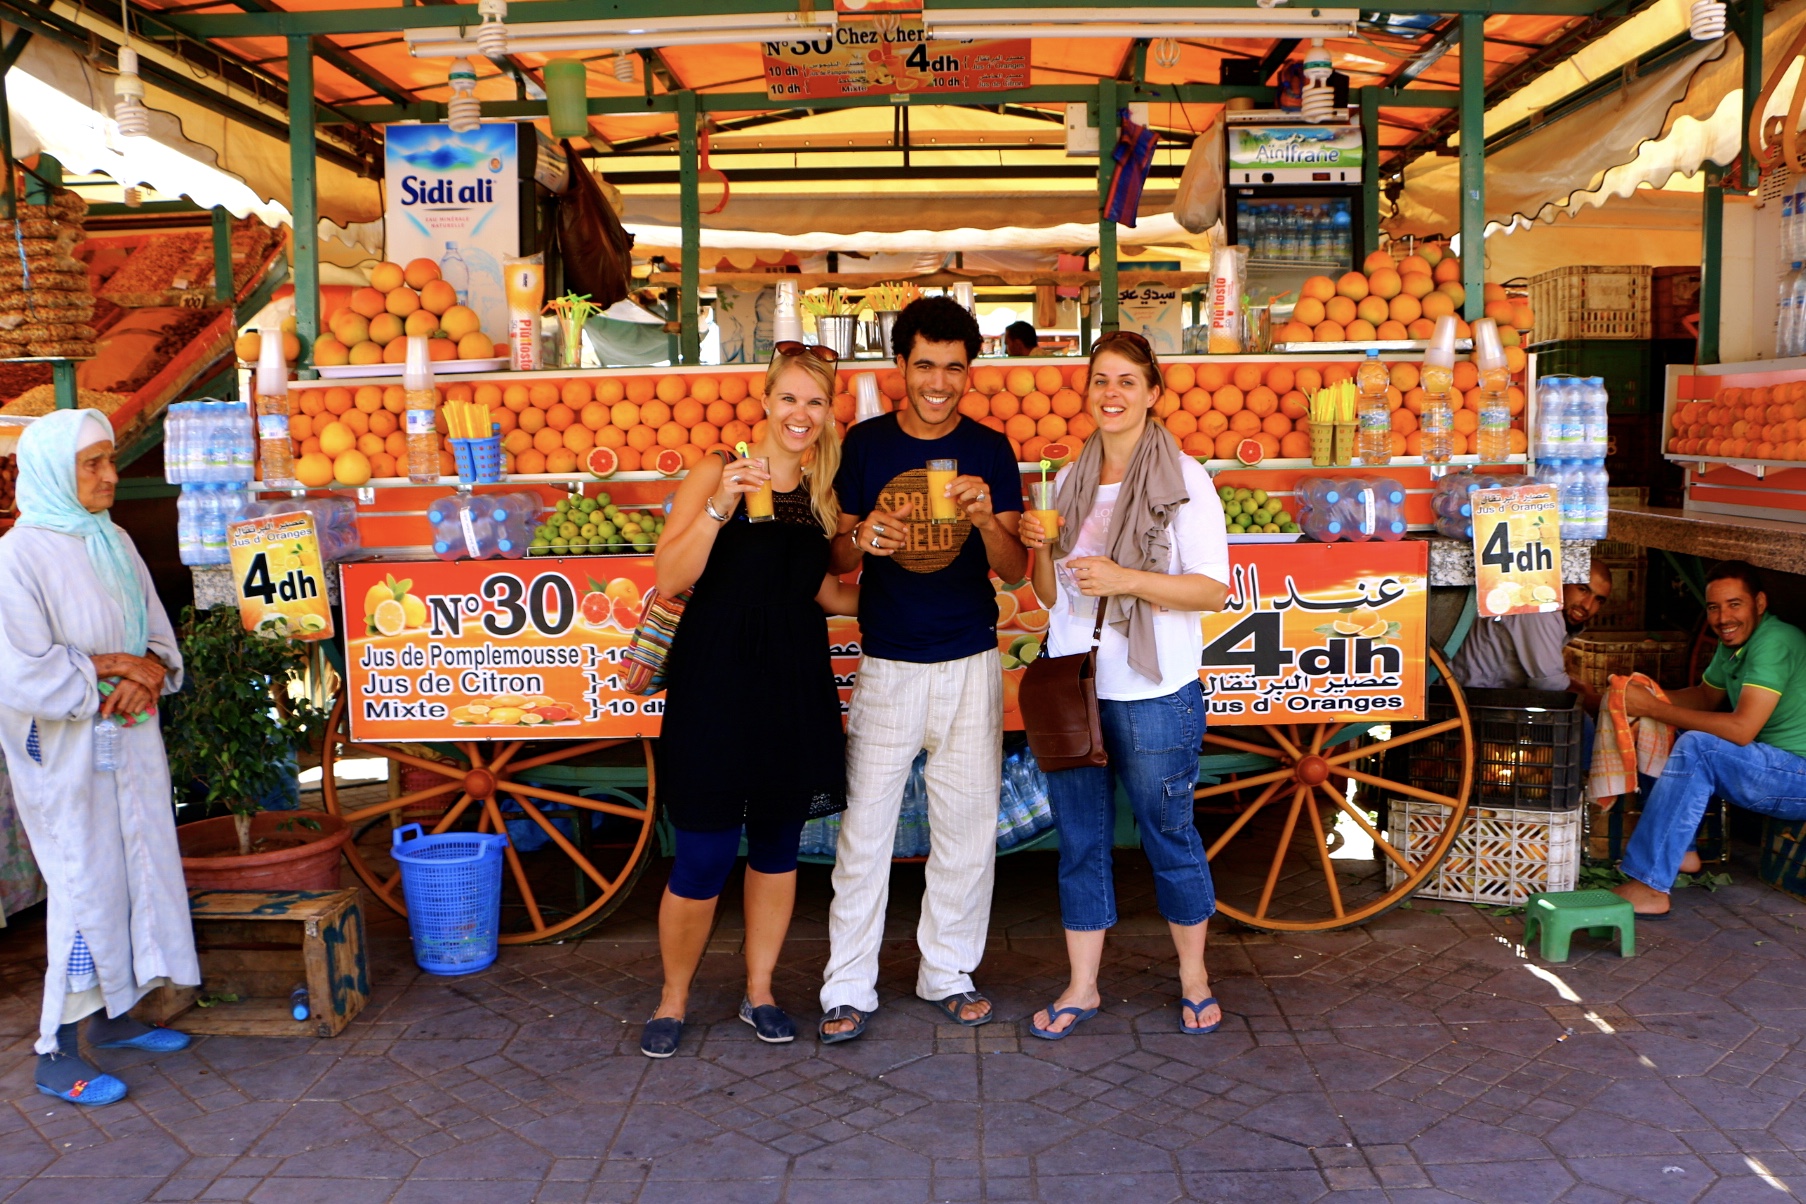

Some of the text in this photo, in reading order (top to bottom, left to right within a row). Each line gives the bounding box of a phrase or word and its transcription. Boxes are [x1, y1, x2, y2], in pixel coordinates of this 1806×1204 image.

[836, 27, 878, 45] Chez
[769, 65, 798, 76] 10 dh
[771, 83, 800, 94] 10 dh
[842, 85, 867, 93] Mixte
[933, 77, 959, 87] 10 dh
[401, 175, 493, 206] Sidi ali
[1477, 506, 1494, 514] Jus
[232, 538, 250, 547] Jus
[1274, 577, 1405, 610] عند
[362, 643, 580, 671] Jus de Pomplemousse
[363, 671, 542, 695] Jus de Citron
[1200, 674, 1399, 696] عصير البرتقال
[366, 700, 446, 720] Mixte
[608, 700, 635, 714] 10
